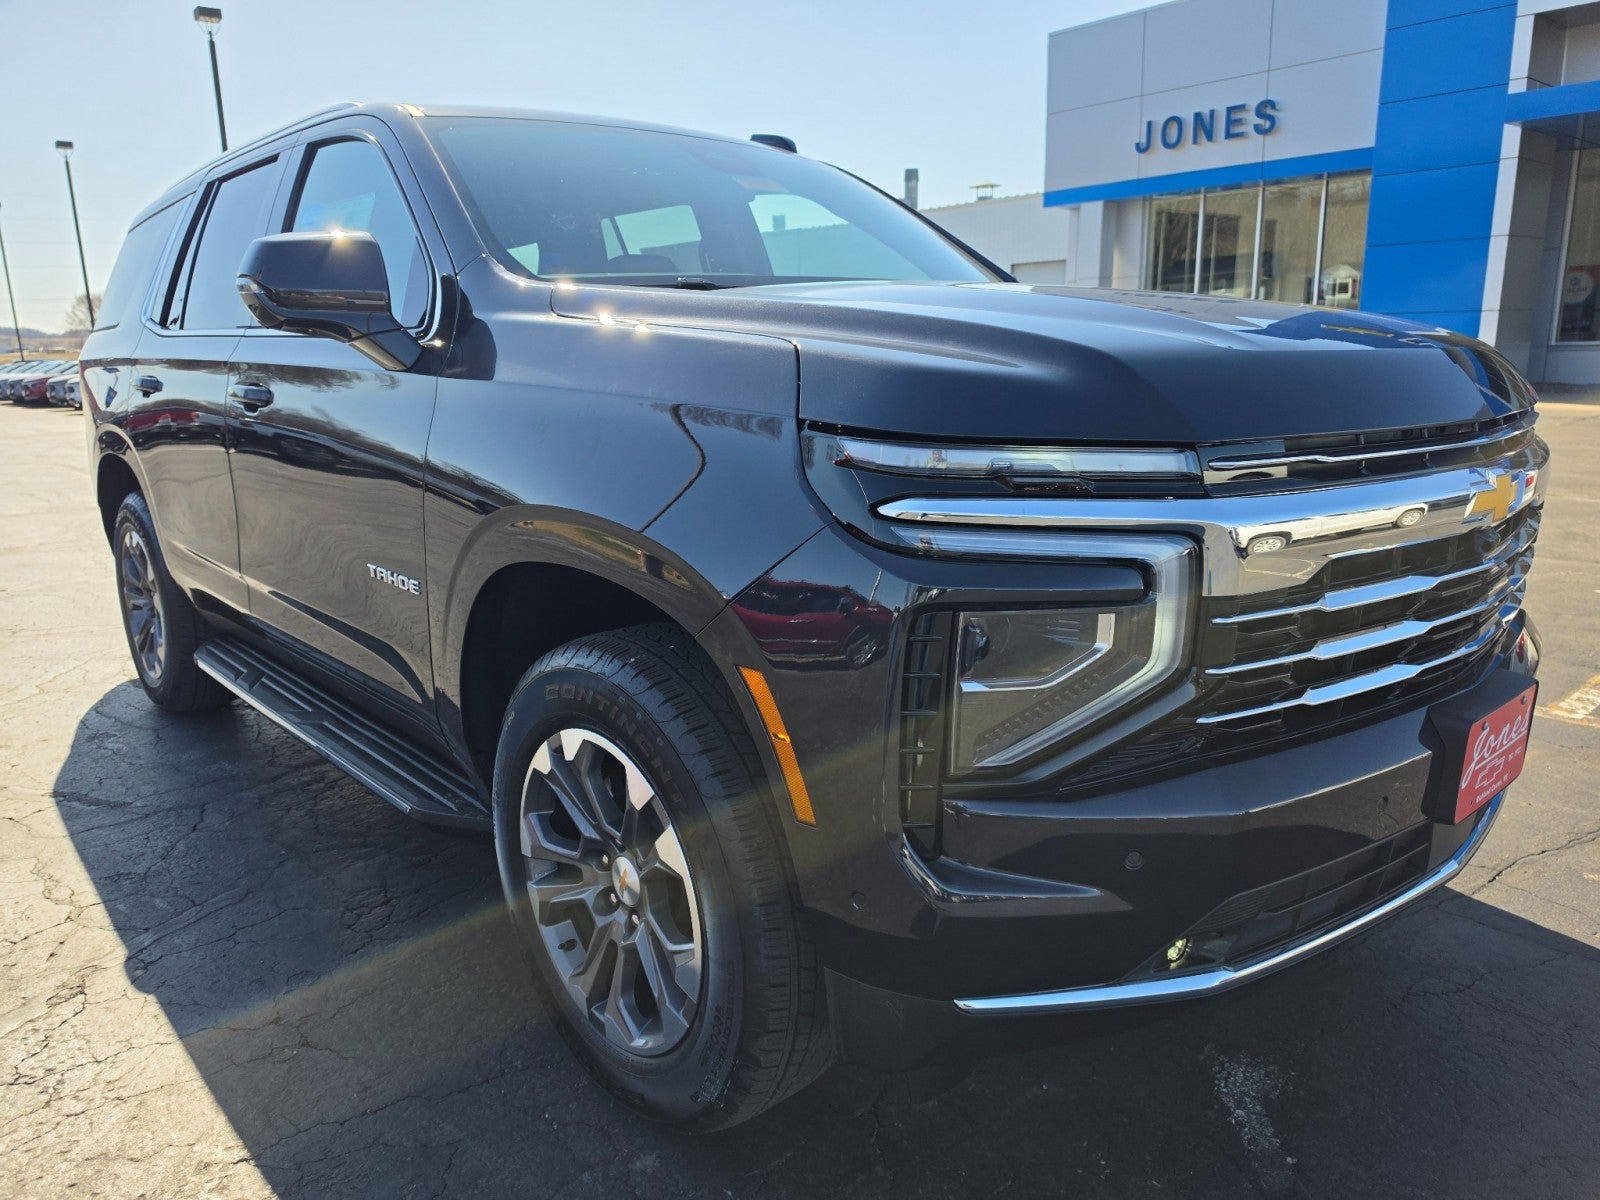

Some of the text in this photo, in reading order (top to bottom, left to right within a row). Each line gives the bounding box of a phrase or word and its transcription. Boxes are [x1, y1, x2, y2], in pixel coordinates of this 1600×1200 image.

[1135, 99, 1278, 154] JONES
[367, 563, 420, 595] TAHOE
[1461, 705, 1532, 789] Jones
